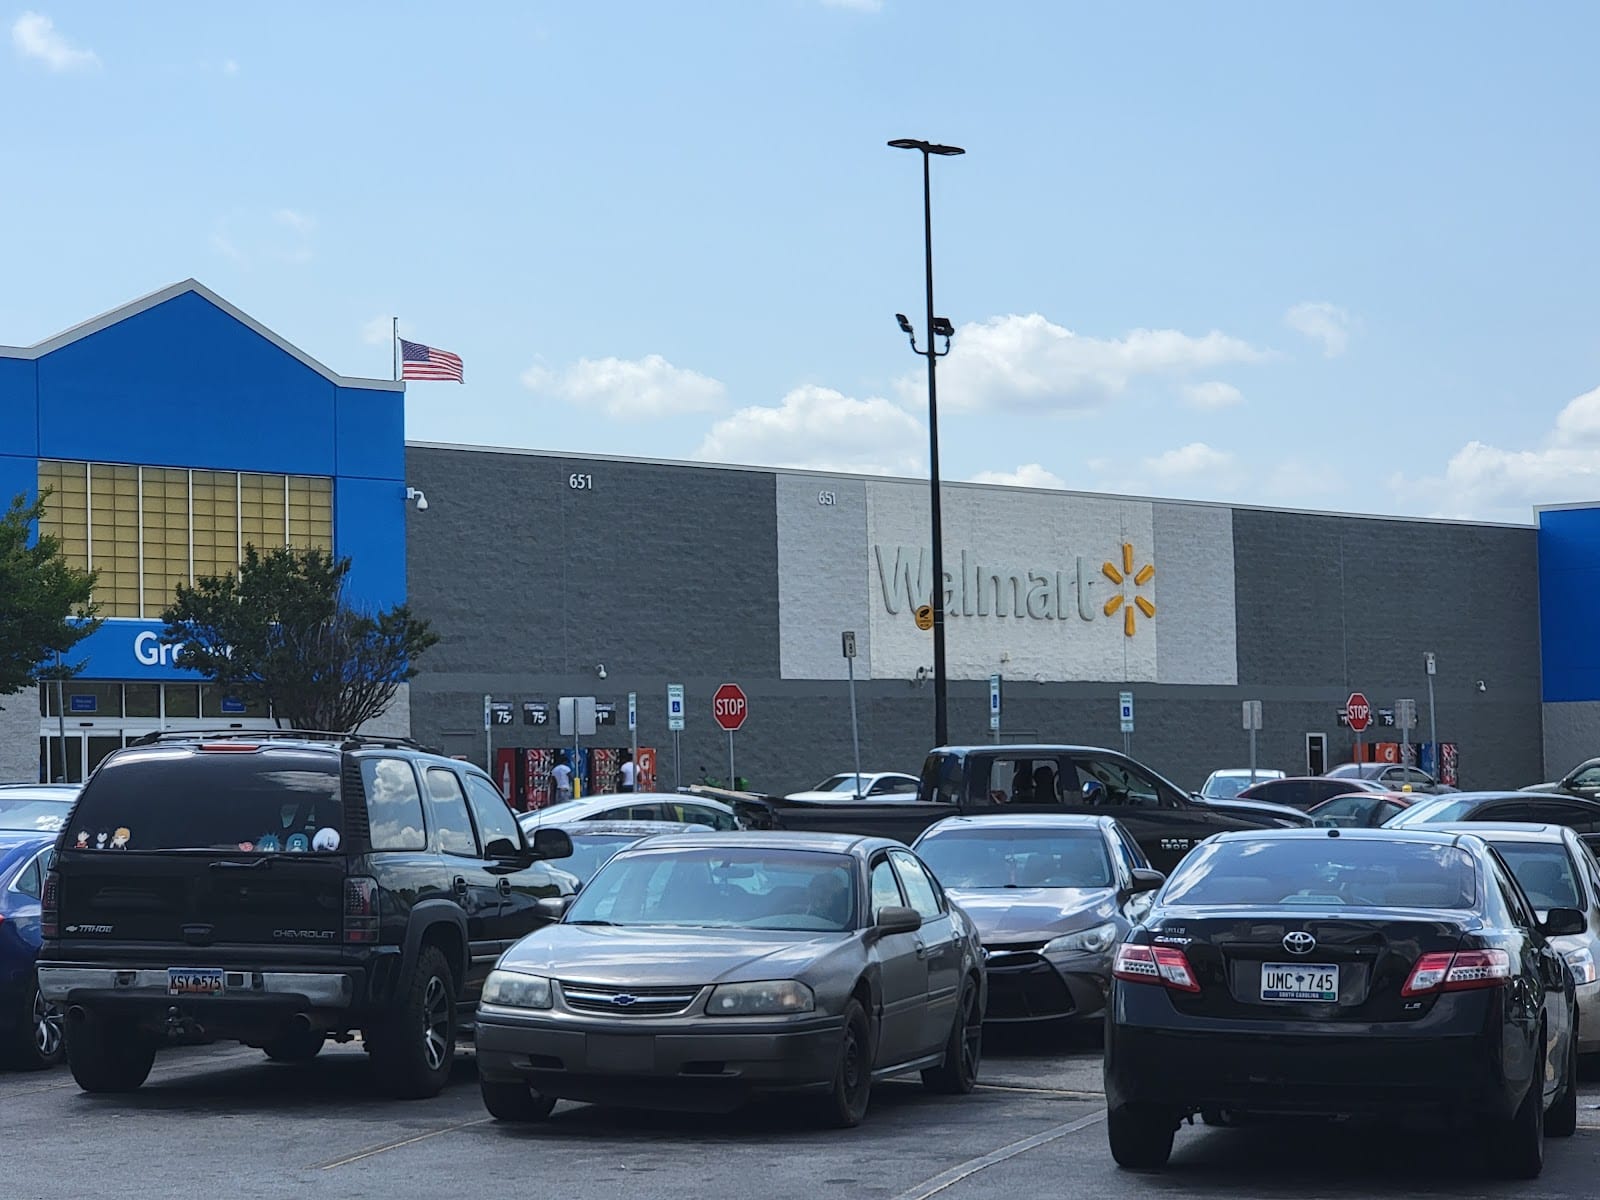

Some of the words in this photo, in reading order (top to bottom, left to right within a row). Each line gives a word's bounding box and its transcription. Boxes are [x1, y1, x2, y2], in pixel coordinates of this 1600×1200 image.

[569, 473, 593, 491] 651
[818, 490, 837, 506] 651
[874, 544, 1097, 622] Walmart
[716, 698, 745, 716] STOP
[1349, 705, 1369, 719] STOP
[273, 929, 336, 939] CHEVROLET
[201, 975, 221, 991] 575
[1267, 972, 1293, 989] UMC
[1307, 973, 1333, 990] 745
